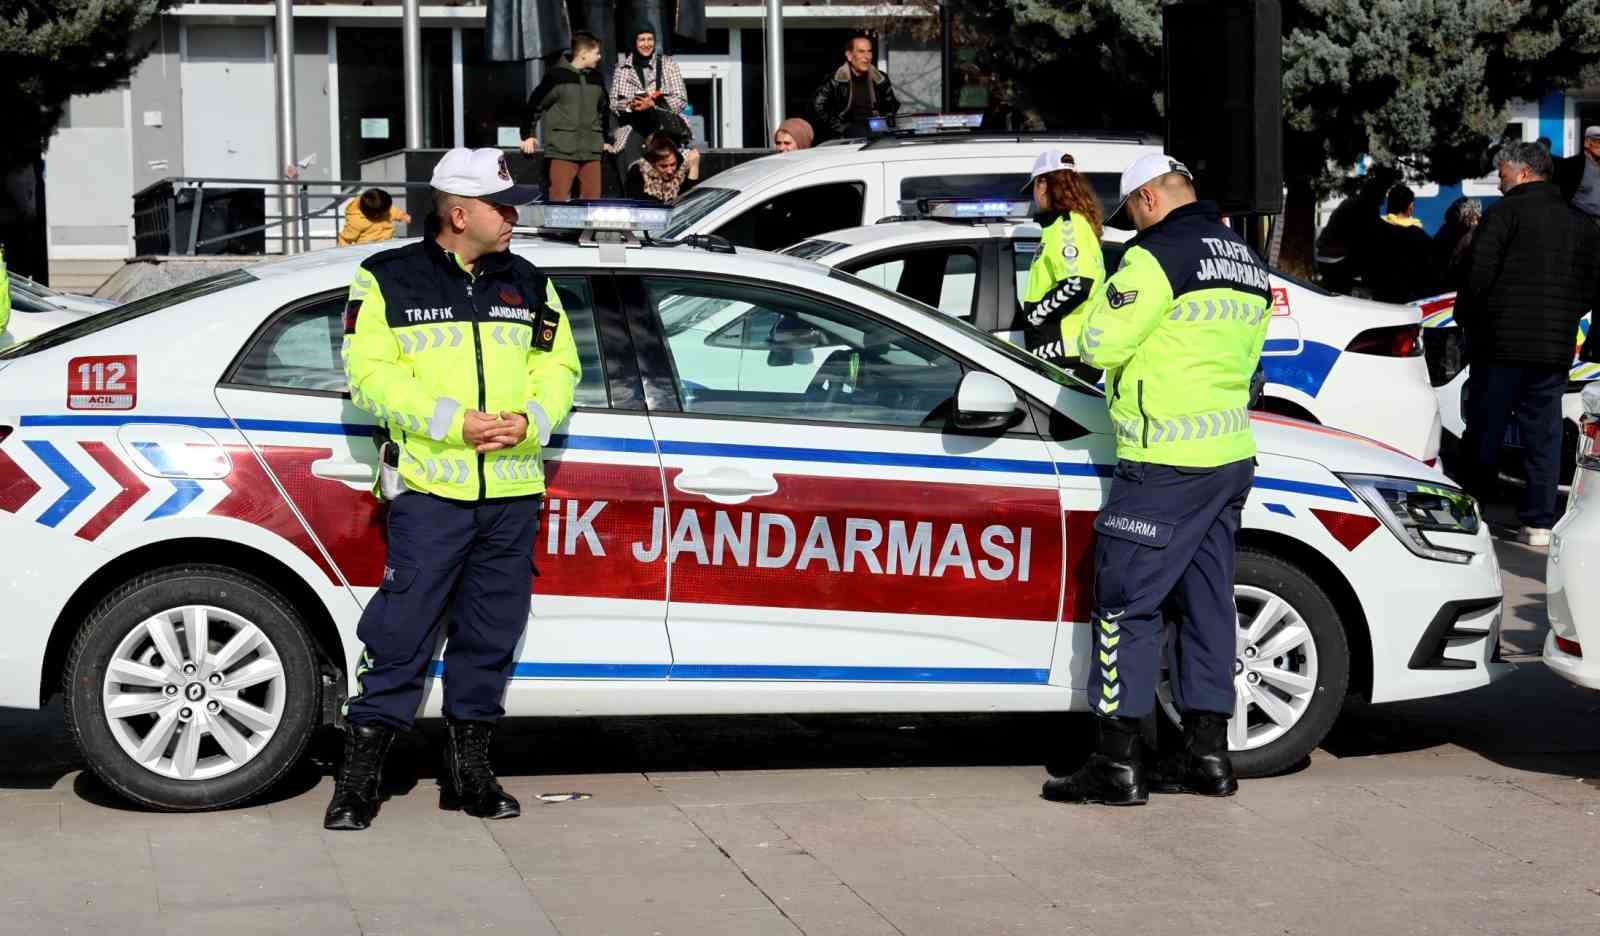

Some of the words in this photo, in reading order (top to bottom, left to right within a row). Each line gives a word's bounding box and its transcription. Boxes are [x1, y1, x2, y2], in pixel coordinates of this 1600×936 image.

[78, 361, 127, 391] 112
[1104, 514, 1157, 538] JANDARMA
[631, 506, 1033, 582] JANDARMASI
